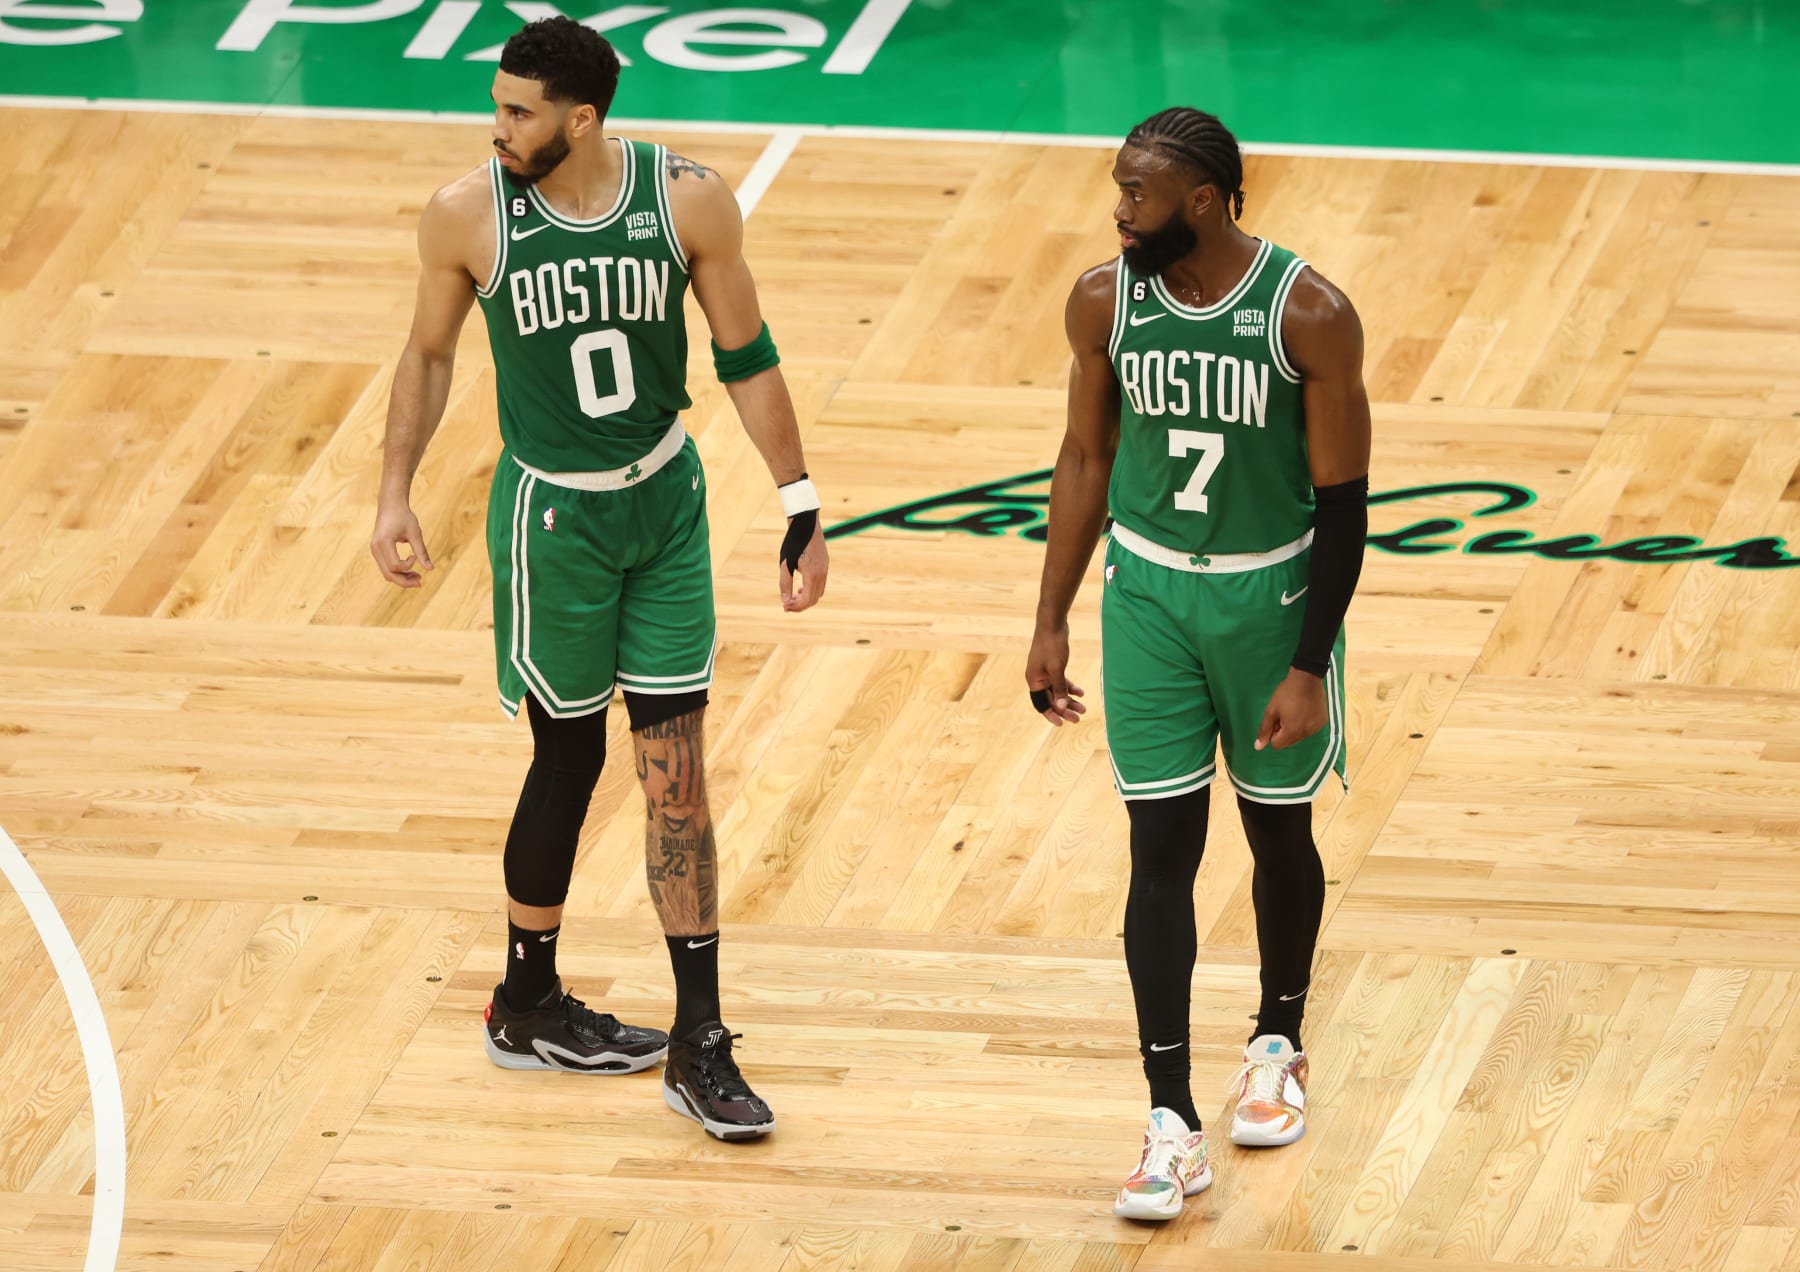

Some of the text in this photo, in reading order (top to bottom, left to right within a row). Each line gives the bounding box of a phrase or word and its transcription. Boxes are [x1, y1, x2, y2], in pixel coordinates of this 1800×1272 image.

[512, 198, 526, 217] 6
[625, 211, 658, 229] VISTA
[627, 226, 658, 241] PRINT
[509, 256, 669, 337] BOSTON
[1133, 281, 1146, 301] 6
[1233, 309, 1265, 325] VISTA
[1233, 325, 1265, 337] PRINT
[570, 328, 636, 419] 0
[1121, 350, 1269, 428] BOSTON
[1168, 428, 1225, 515] 7
[662, 850, 687, 878] 22
